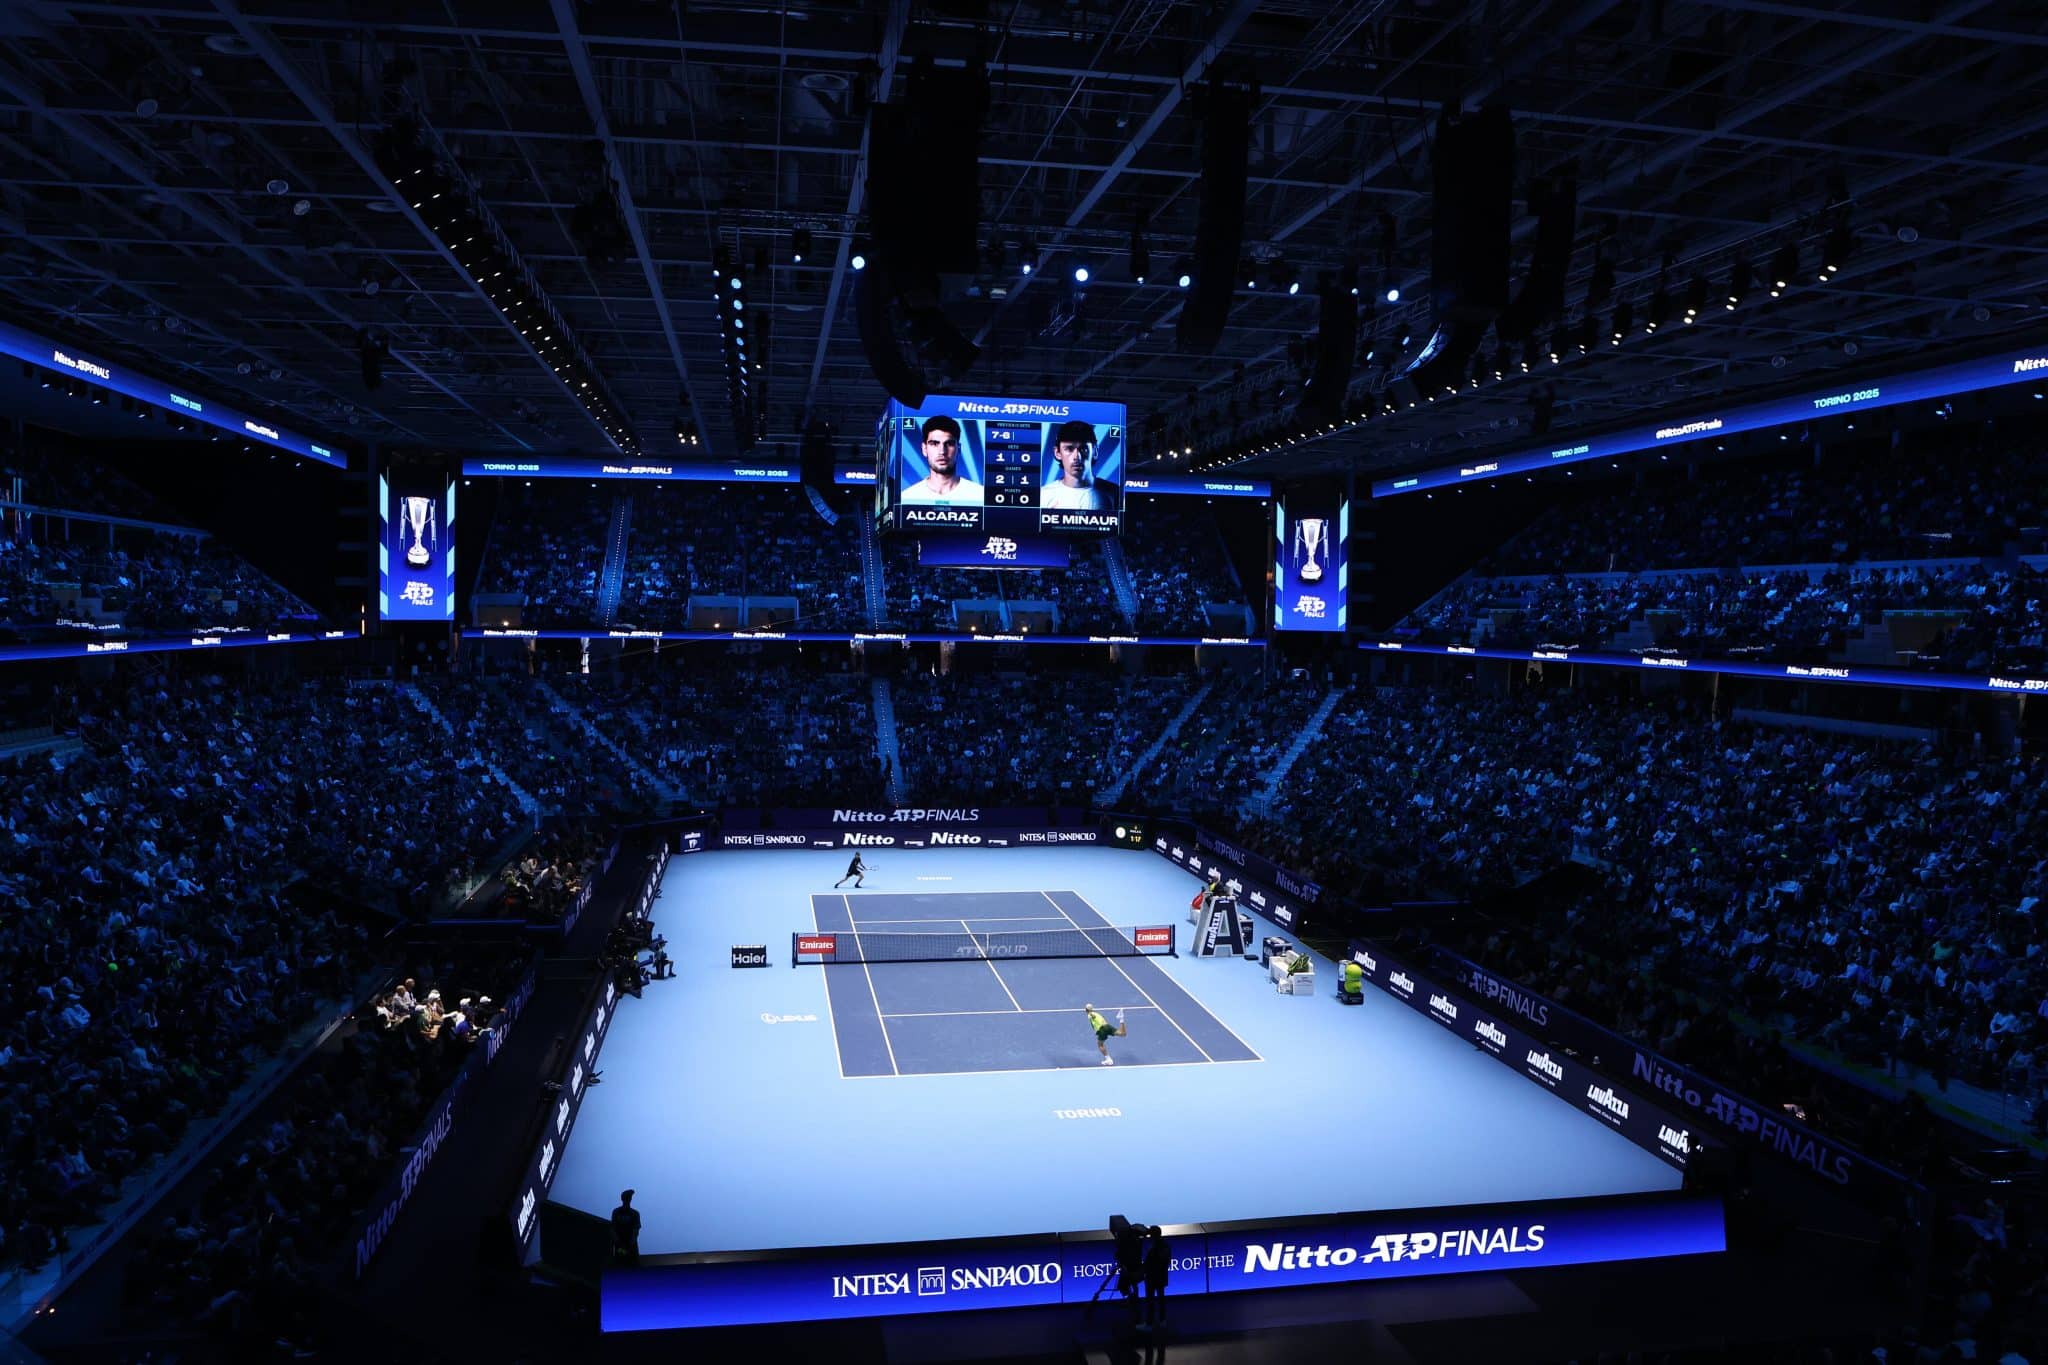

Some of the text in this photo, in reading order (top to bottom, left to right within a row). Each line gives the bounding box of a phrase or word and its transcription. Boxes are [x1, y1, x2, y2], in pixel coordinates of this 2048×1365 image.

[1814, 388, 1880, 409] TORINO 2025
[957, 402, 999, 414] Nitto
[1028, 405, 1070, 416] FINALS
[904, 419, 913, 428] 1
[1112, 427, 1119, 436] 7
[996, 452, 1031, 463] 1 0
[483, 463, 516, 471] TORINO
[734, 469, 766, 477] TORINO
[995, 475, 1029, 485] 2 1
[1204, 483, 1233, 491] TORINO
[995, 494, 1030, 504] 0 0
[906, 510, 979, 522] ALCARAZ
[1041, 514, 1118, 526] DE MINAUR
[1989, 678, 2020, 689] Nitto
[832, 808, 980, 822] Nitto ATP FINALS
[724, 836, 752, 845] INTESA
[843, 832, 895, 846] Nitto
[930, 832, 982, 845] Nitto
[1275, 871, 1300, 896] Nitto
[1206, 912, 1222, 949] LAVAZZA
[1136, 933, 1169, 942] Emirates
[799, 941, 834, 949] Emirates
[732, 953, 765, 964] Haier
[1429, 993, 1458, 1019] LAVAZZA
[1499, 985, 1549, 1027] FINALS
[1475, 1019, 1507, 1048] LAVAZZA
[1526, 1049, 1563, 1081] LAVAZZA
[1586, 1084, 1630, 1119] LAVAZZA
[1053, 1107, 1122, 1120] TORINO
[1632, 1051, 1701, 1108] Nitto
[1760, 1118, 1850, 1185] FINALS
[422, 1101, 451, 1172] FINALS
[1073, 1263, 1113, 1278] HOST
[1181, 1257, 1201, 1270] OF
[1203, 1254, 1235, 1269] THE
[1243, 1244, 1357, 1273] Nitto
[1360, 1233, 1437, 1265] ATP
[1439, 1225, 1545, 1258] FINALS
[832, 1262, 1062, 1298] INTESA SANPAOLO
